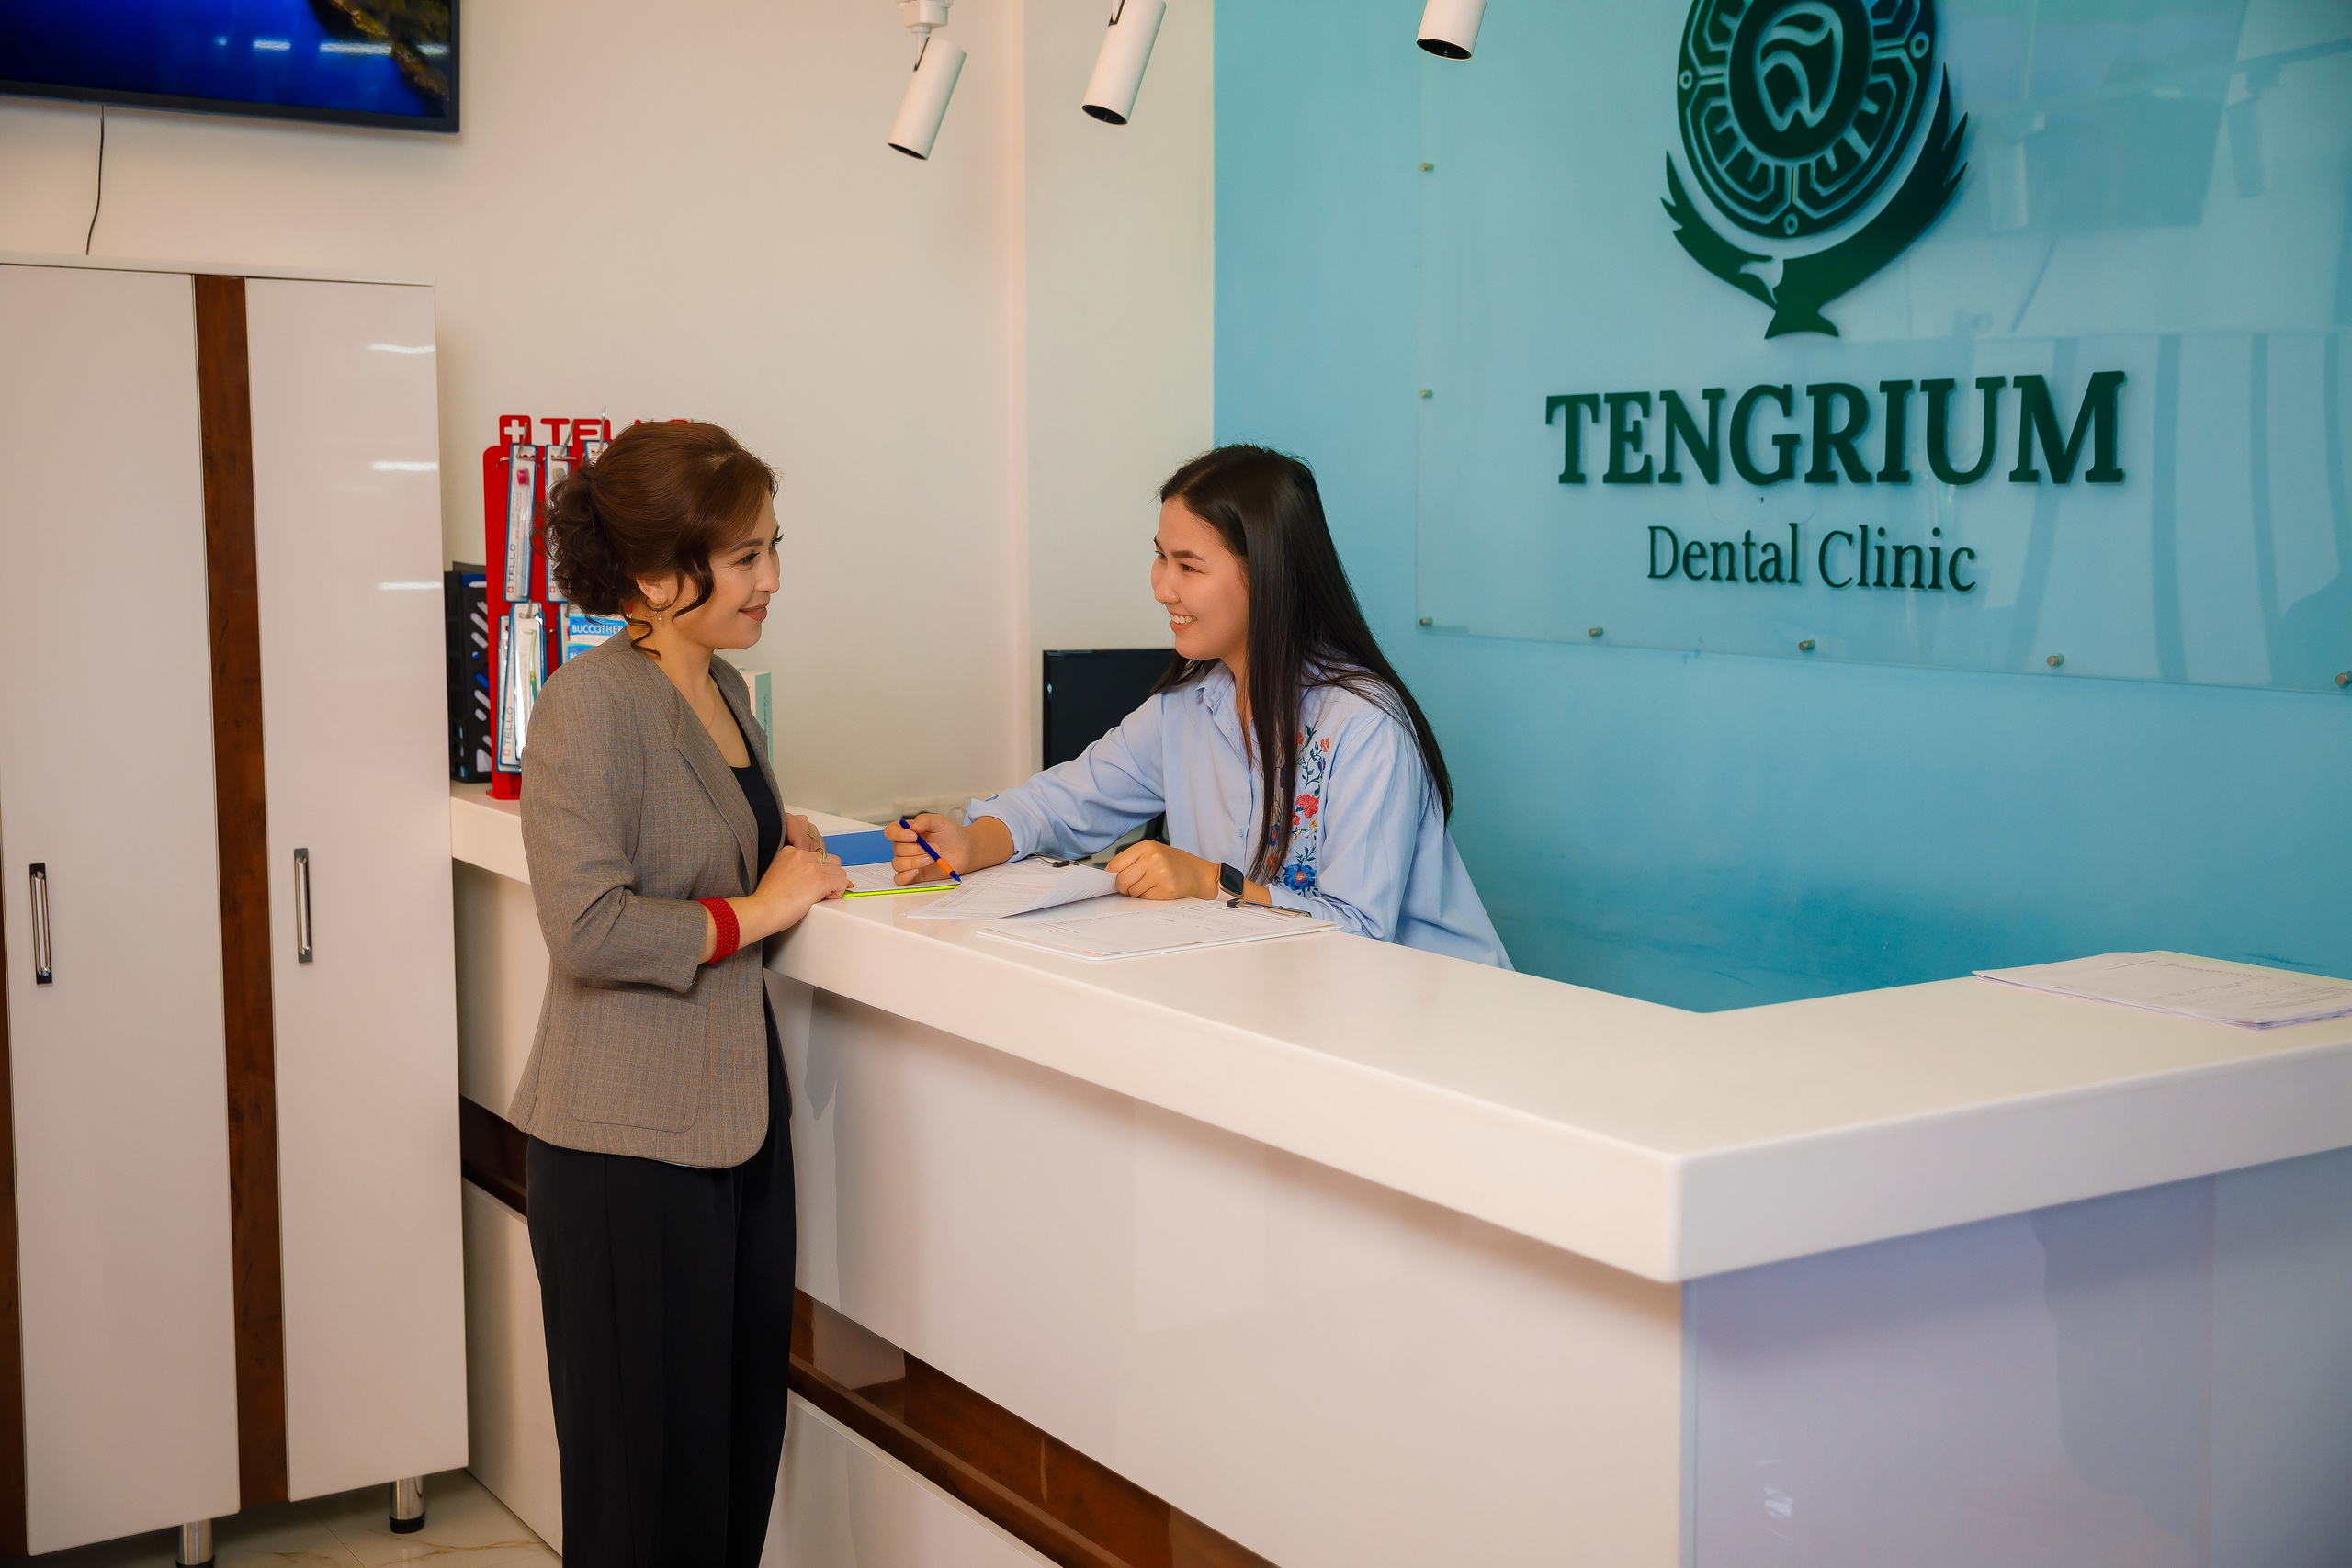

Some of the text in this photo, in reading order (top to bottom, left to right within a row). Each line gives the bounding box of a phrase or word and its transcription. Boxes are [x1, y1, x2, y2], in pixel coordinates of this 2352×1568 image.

[1545, 371, 2125, 485] TENGRIUM
[508, 544, 516, 581] TELLO
[1647, 523, 1976, 592] Dental Clinic
[503, 706, 514, 746] TELLO
